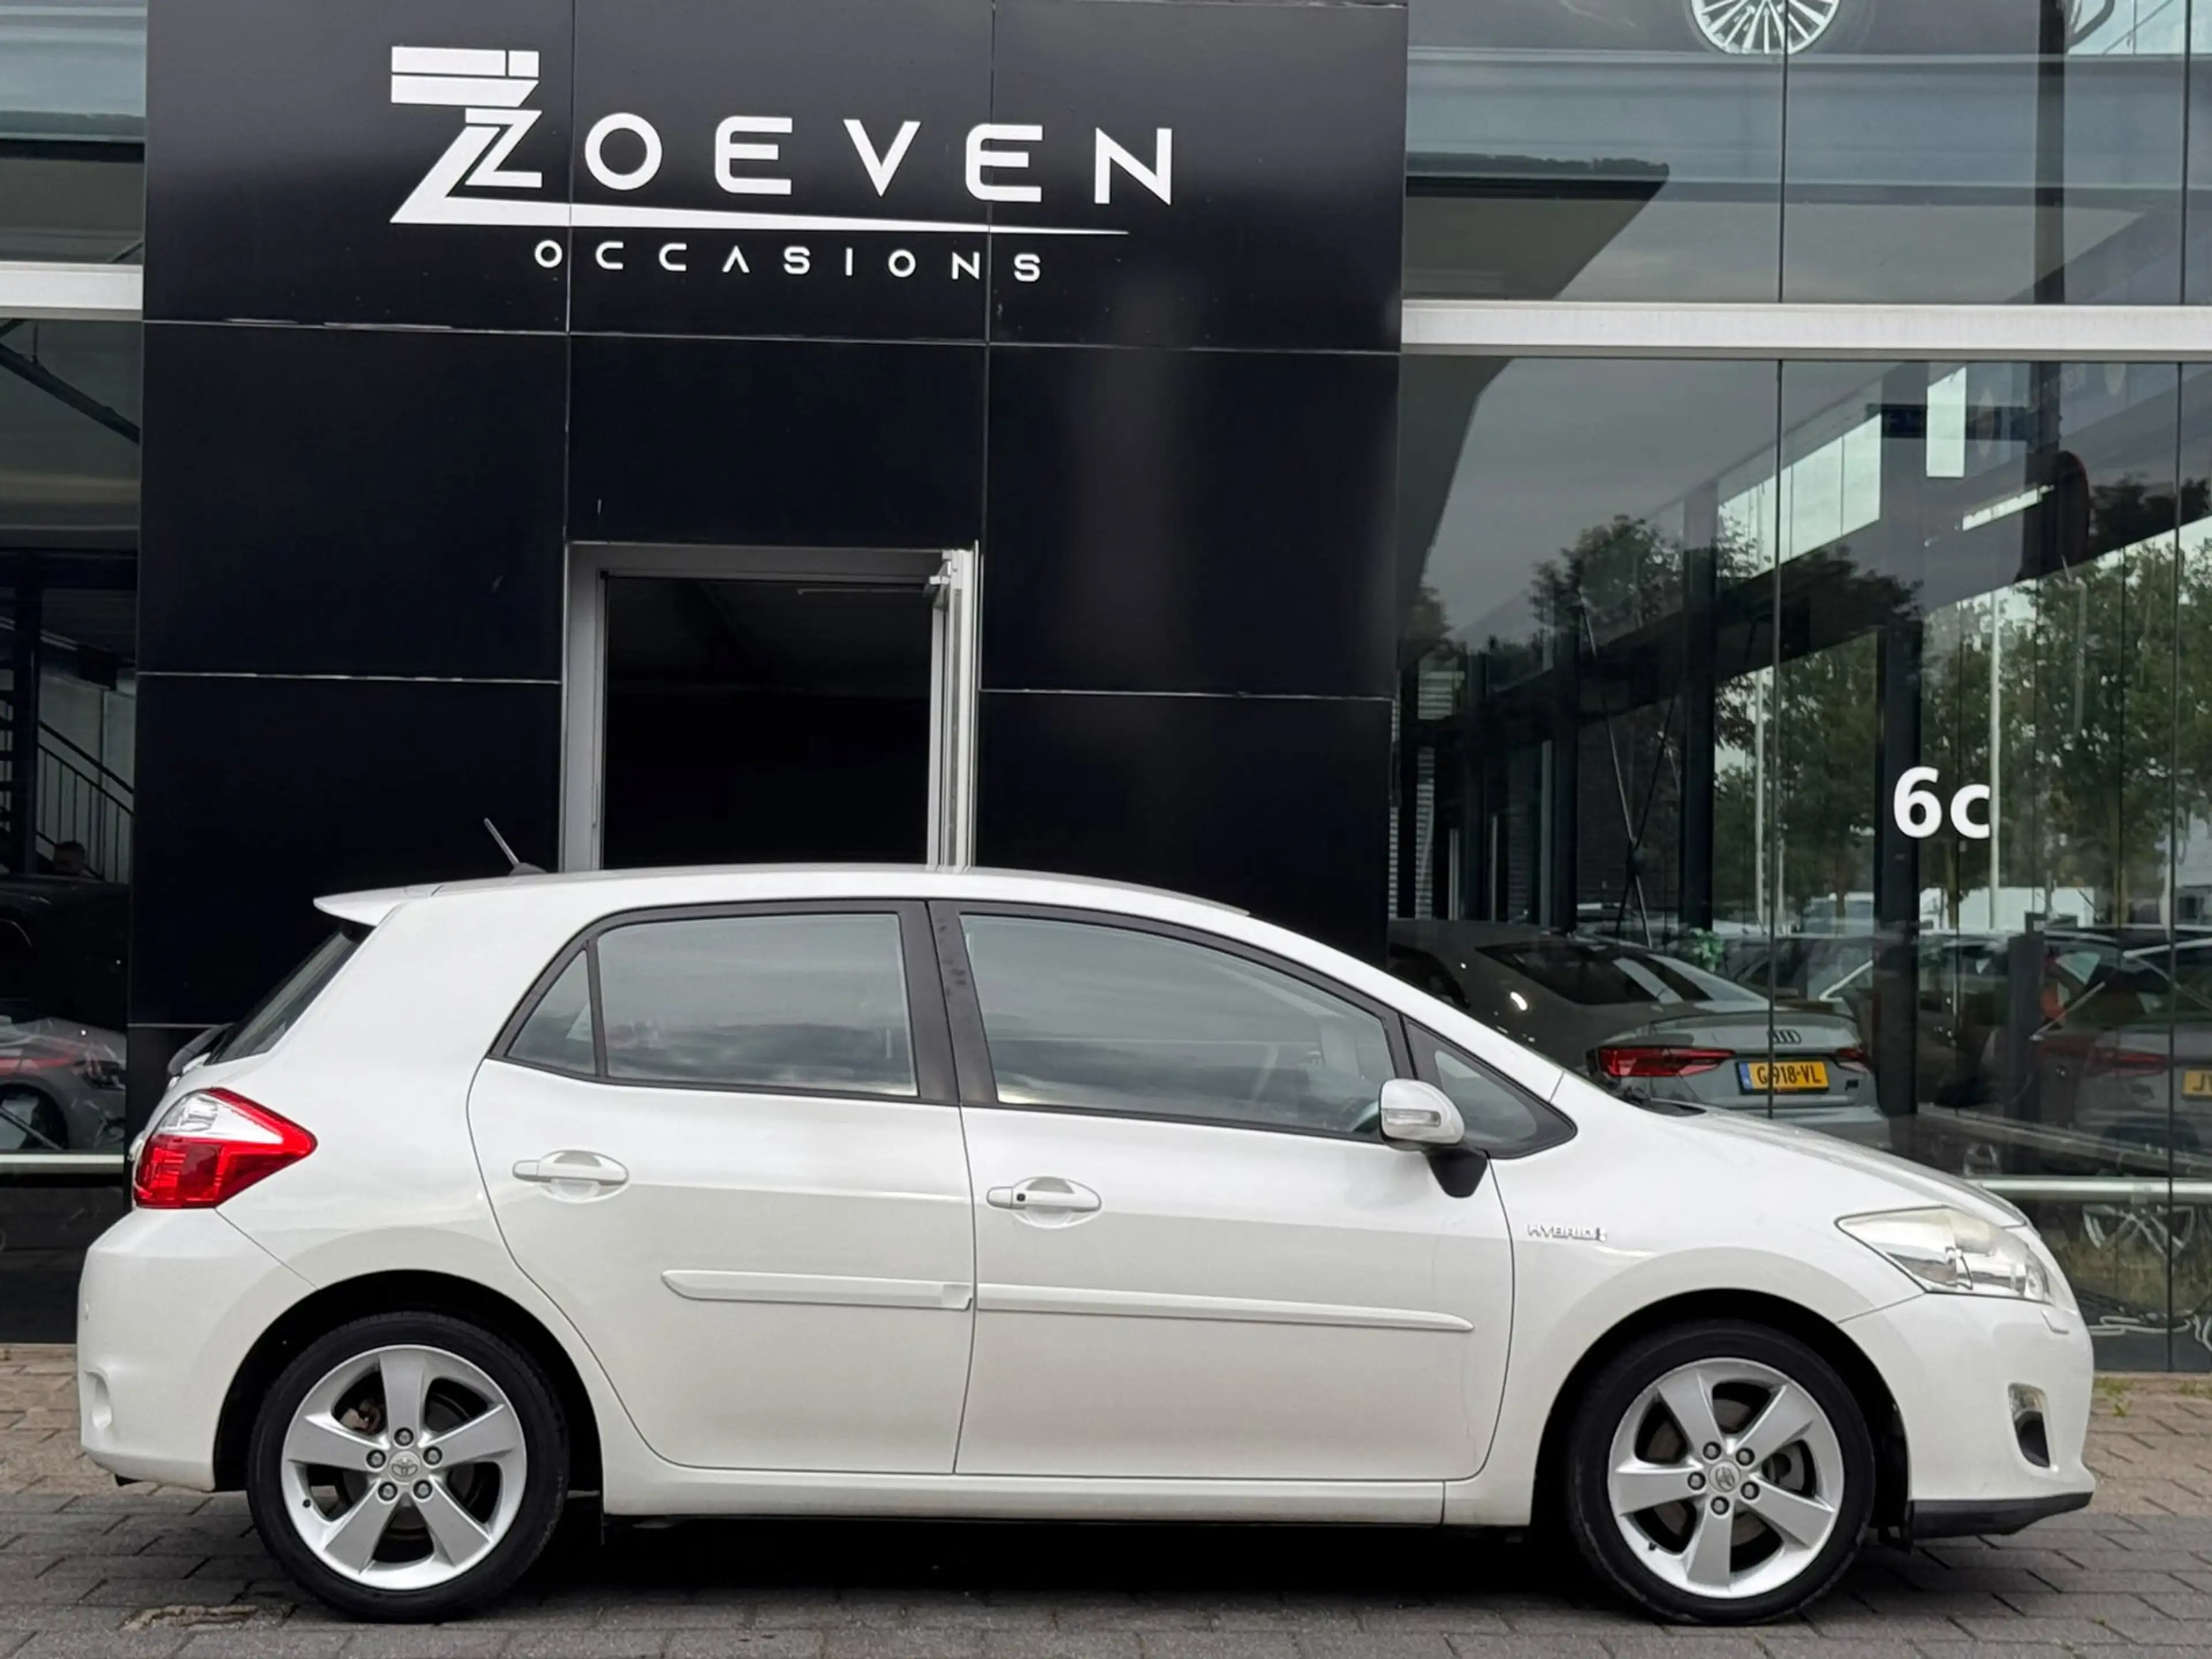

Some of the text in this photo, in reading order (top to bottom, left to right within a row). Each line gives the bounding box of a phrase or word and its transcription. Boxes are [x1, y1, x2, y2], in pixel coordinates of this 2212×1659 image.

[391, 47, 1172, 234] ZOEVEN
[535, 240, 1040, 281] OCCASIONS
[1893, 766, 1990, 839] 6c
[1757, 1065, 1821, 1085] G918-VL
[1525, 1222, 1594, 1240] HYBRID
